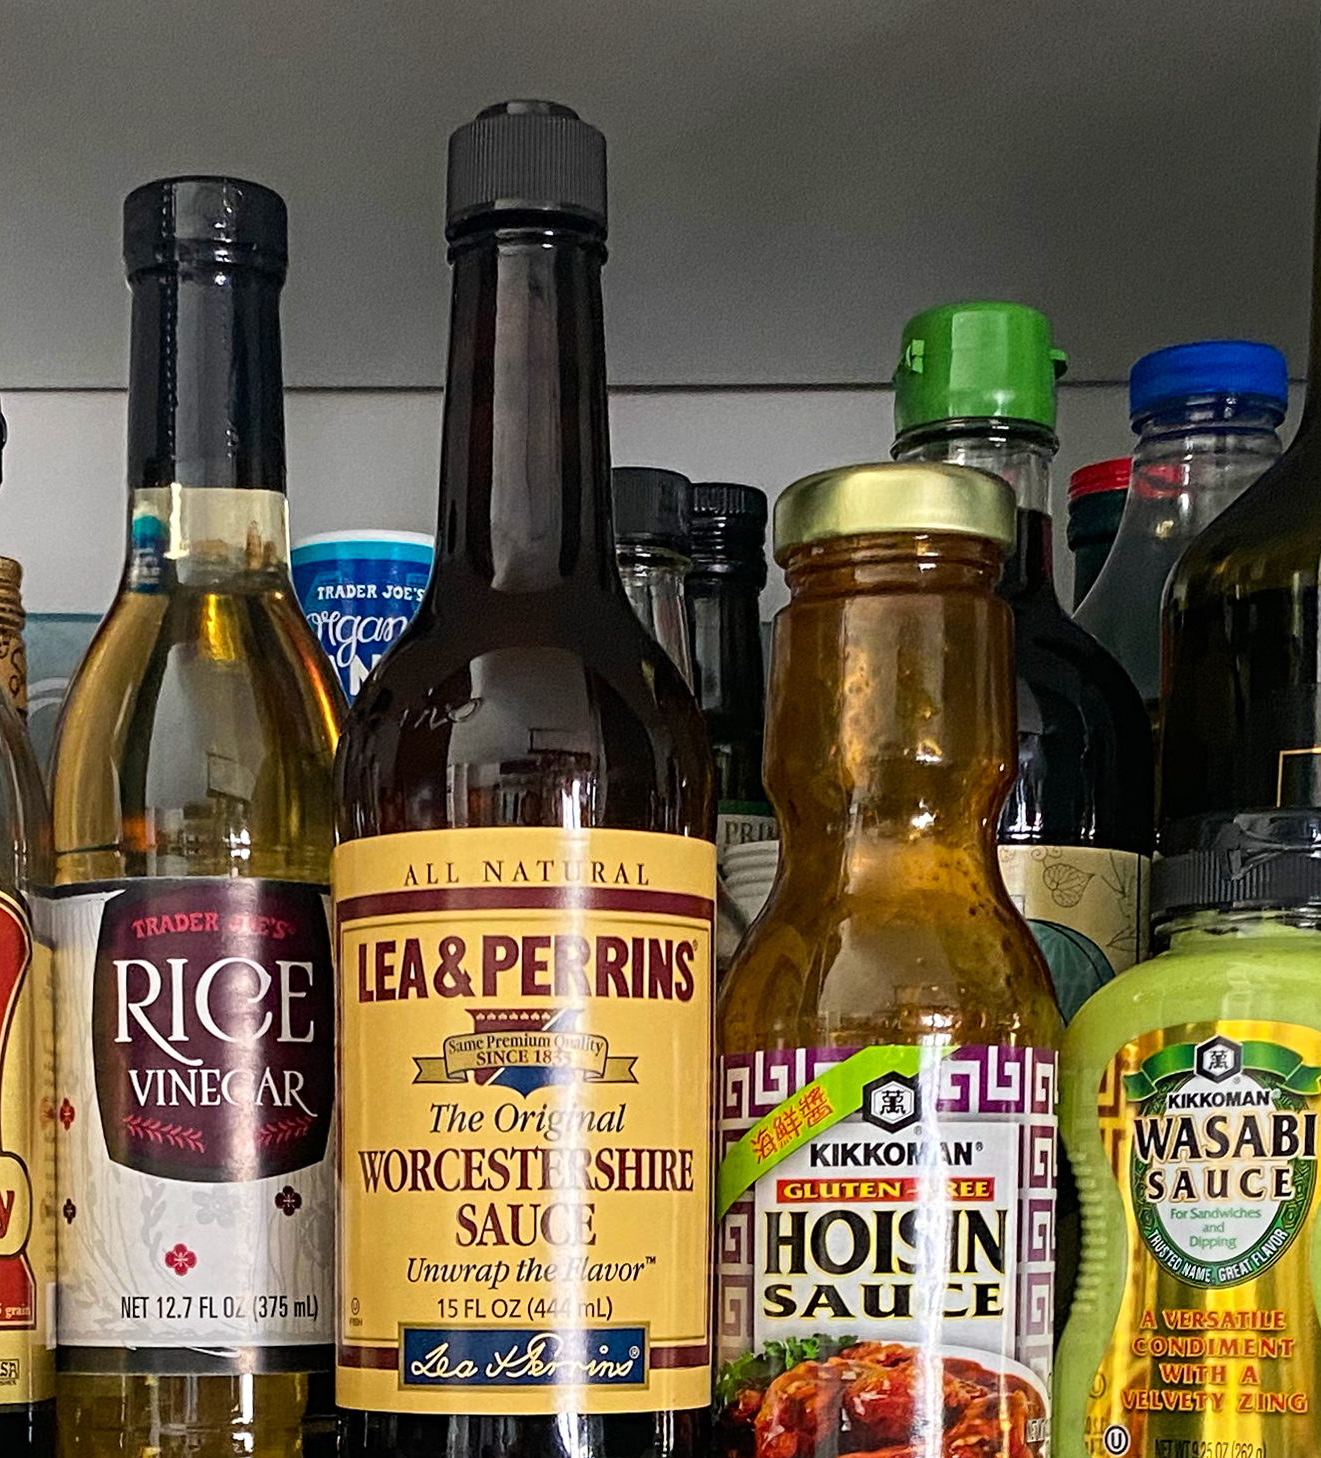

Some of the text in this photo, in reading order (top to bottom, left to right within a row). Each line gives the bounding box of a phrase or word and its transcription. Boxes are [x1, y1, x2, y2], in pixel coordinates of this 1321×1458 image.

[317, 584, 425, 602] TRADER JOE'S
[404, 859, 649, 886] ALL NATURAL
[132, 912, 219, 939] TRADER
[113, 957, 315, 1067] RICE
[449, 1034, 604, 1056] Same Premium Quality
[129, 1070, 318, 1117] VINEGAR
[1168, 1090, 1270, 1110] KIKKOMAN
[430, 1103, 626, 1142] The Original
[1132, 1112, 1318, 1162] WASABI
[810, 1142, 973, 1168] KIKKOMAN
[358, 1147, 694, 1193] WORCESTERSHIRE
[1147, 1168, 1294, 1202] SAUCE
[455, 1203, 597, 1247] SAUCE
[1171, 1207, 1261, 1220] For Sandwiches
[1189, 1235, 1236, 1249] Dipping
[407, 1258, 509, 1289] Unwrap
[516, 1257, 555, 1282] the
[763, 1282, 1004, 1320] SAUCE
[1132, 1338, 1294, 1358] CONDIMENT
[1121, 1389, 1308, 1413] VELVETY ZING
